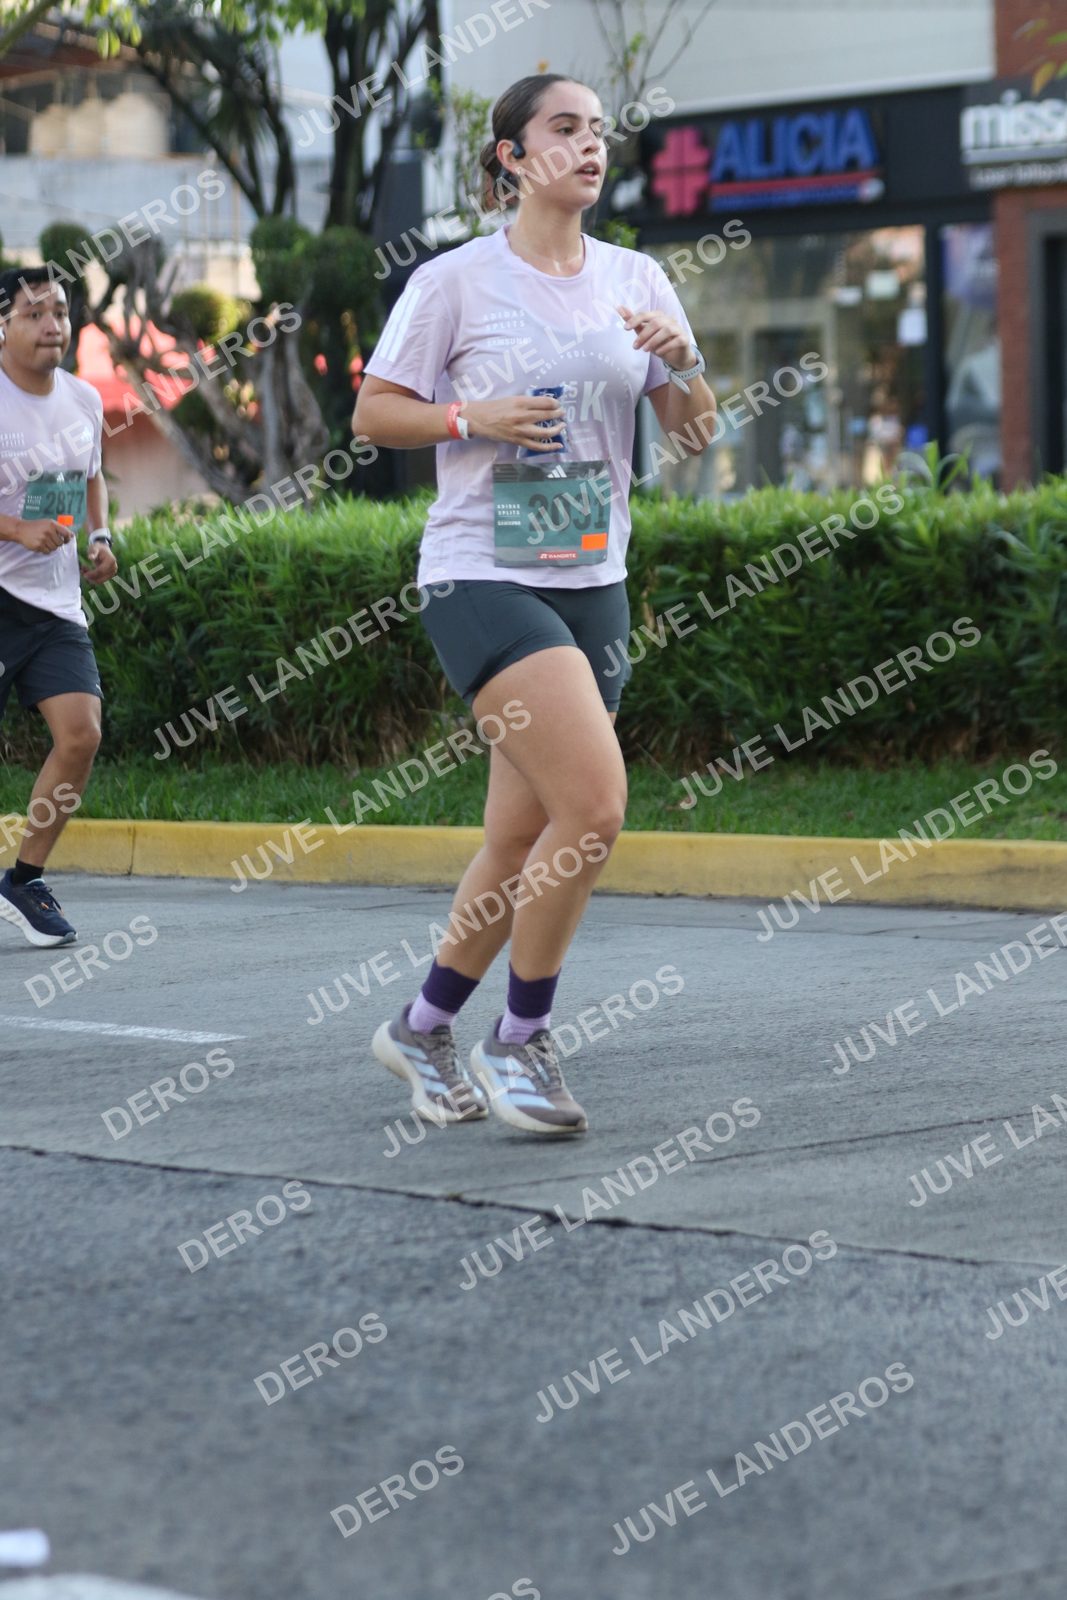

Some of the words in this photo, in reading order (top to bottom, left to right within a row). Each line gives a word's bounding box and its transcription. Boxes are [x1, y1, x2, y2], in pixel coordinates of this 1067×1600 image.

[960, 88, 1067, 150] miss
[708, 107, 879, 182] ALICIA
[483, 310, 526, 321] ADIDAS
[485, 320, 526, 331] SPLITS
[580, 381, 607, 422] K
[44, 491, 84, 515] 2877
